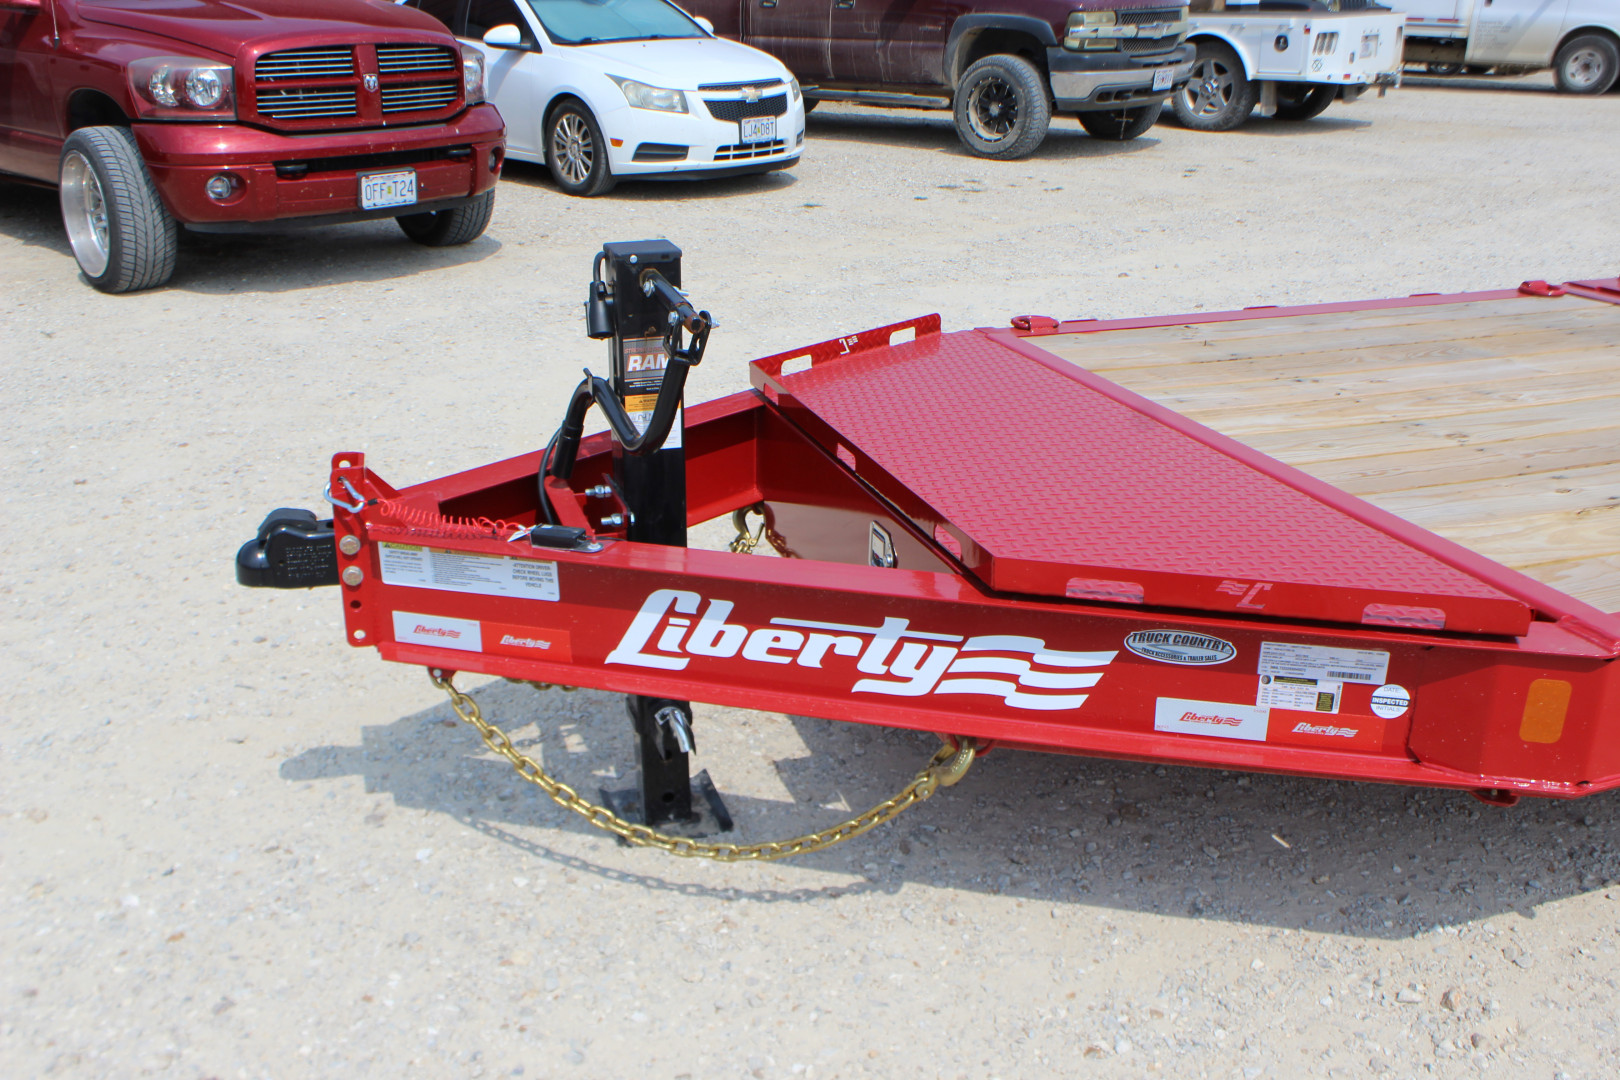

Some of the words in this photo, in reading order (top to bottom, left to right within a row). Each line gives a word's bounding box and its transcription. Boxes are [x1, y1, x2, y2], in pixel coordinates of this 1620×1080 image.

[392, 178, 414, 198] T24
[627, 353, 670, 373] RAM
[413, 624, 447, 638] Liberty
[499, 634, 536, 648] Liberty
[604, 588, 965, 698] Liberty
[1131, 632, 1172, 644] TRUCK
[1172, 633, 1230, 652] COUNTRY
[1141, 647, 1155, 656] TRUCK
[1154, 652, 1182, 661] ACCESSORIES
[1204, 654, 1217, 662] SALES
[1372, 697, 1409, 706] INSPECTED
[1178, 711, 1225, 727] Liberty
[1291, 721, 1340, 736] Liberty
